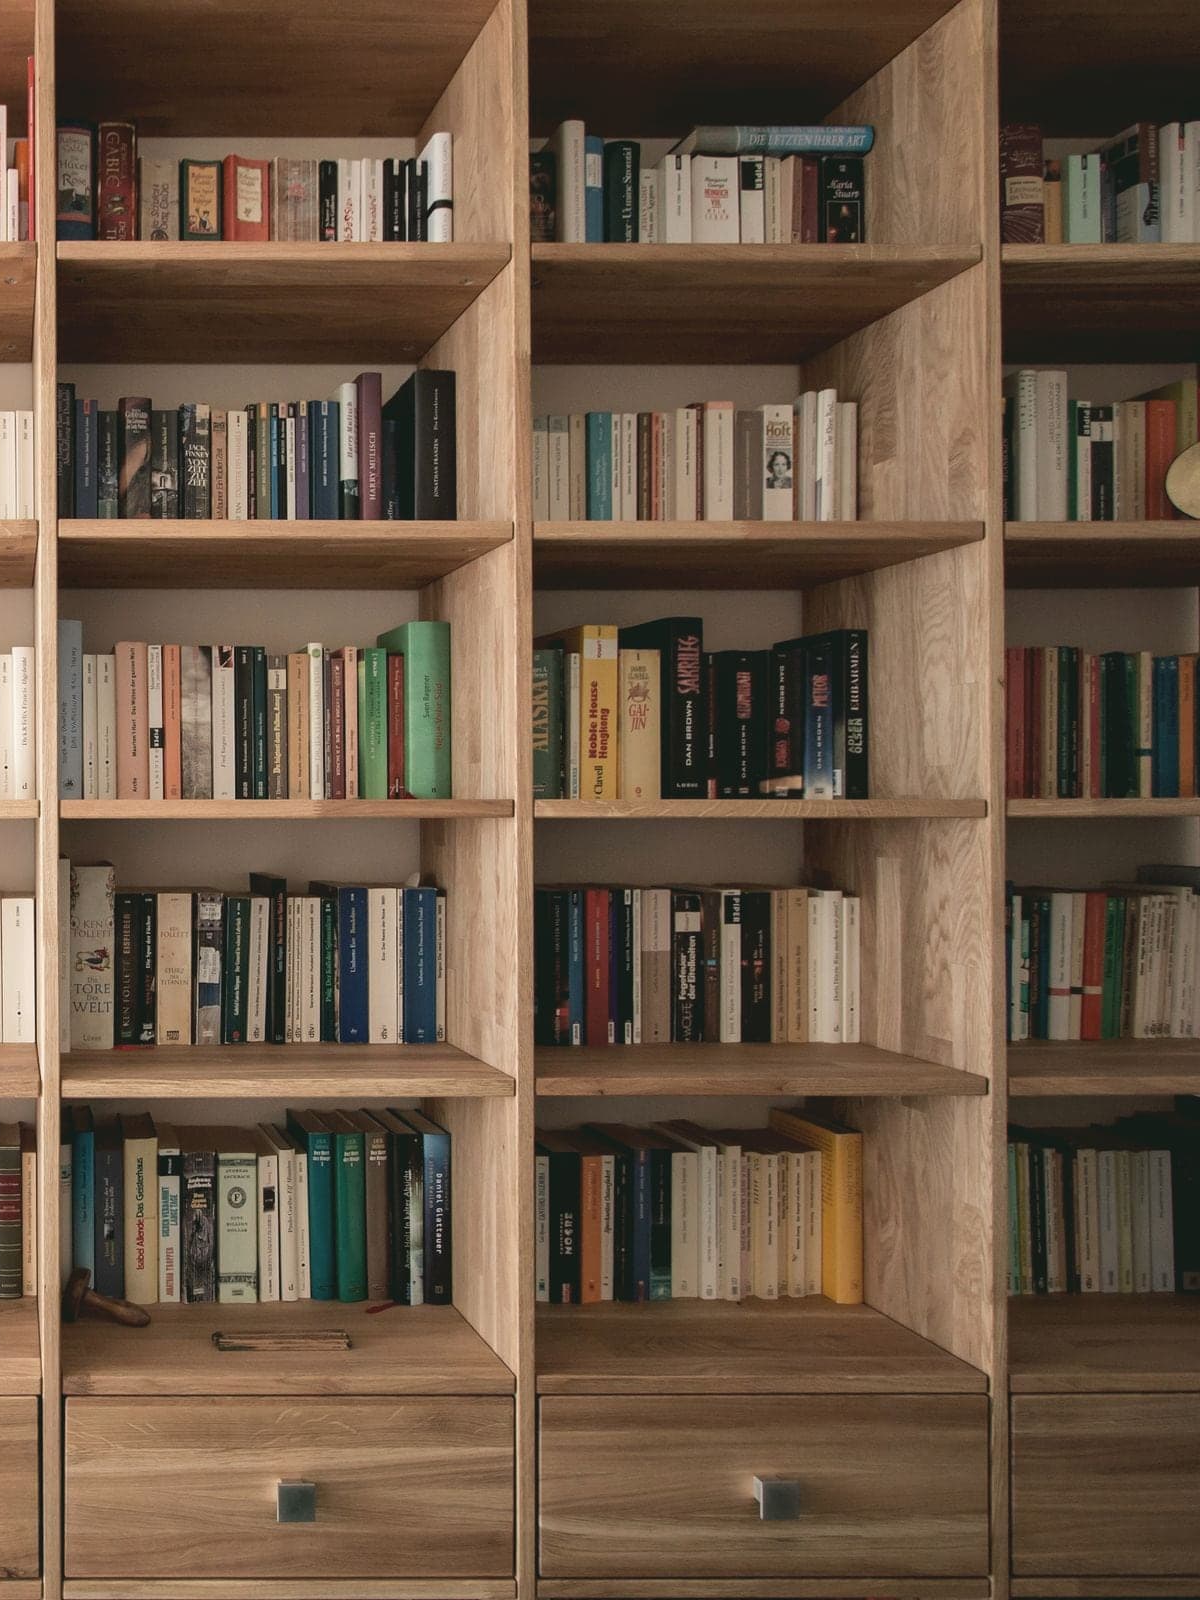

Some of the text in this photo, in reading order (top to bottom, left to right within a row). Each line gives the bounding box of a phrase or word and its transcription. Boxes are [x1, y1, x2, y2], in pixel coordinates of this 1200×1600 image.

[750, 134, 866, 146] DIE LETZTEN IHRER ART
[754, 163, 763, 190] PIPER
[766, 424, 791, 437] Holt
[186, 466, 209, 474] ZEIT
[187, 458, 207, 466] VON
[368, 432, 377, 500] HARRY MULISCH
[186, 479, 209, 487] ZEIT
[677, 635, 700, 694] SAKRILEG
[850, 642, 860, 711] ERBARMEN
[422, 675, 433, 718] Sven Regener
[812, 674, 829, 707] METEOR
[532, 679, 549, 752] ALASKA
[588, 680, 599, 759] Noble House
[630, 717, 648, 732] JIN
[685, 700, 693, 740] BROWN
[855, 718, 863, 753] OLSEN
[594, 765, 604, 795] Clavell
[83, 920, 104, 928] KEN
[732, 898, 741, 923] PIPER
[73, 929, 112, 938] FOLLETT
[121, 912, 132, 1027] KEN FOLLETT EISFIEBER
[677, 953, 688, 1000] Fegefeuer
[685, 936, 696, 1000] der Eitelkeiten
[73, 984, 111, 994] TORE
[72, 1001, 112, 1013] WELT
[135, 1157, 145, 1270] Isabel Allende Das Geisterhaus
[435, 1173, 443, 1254] Daniel Glattauer
[563, 1212, 573, 1255] MOORE
